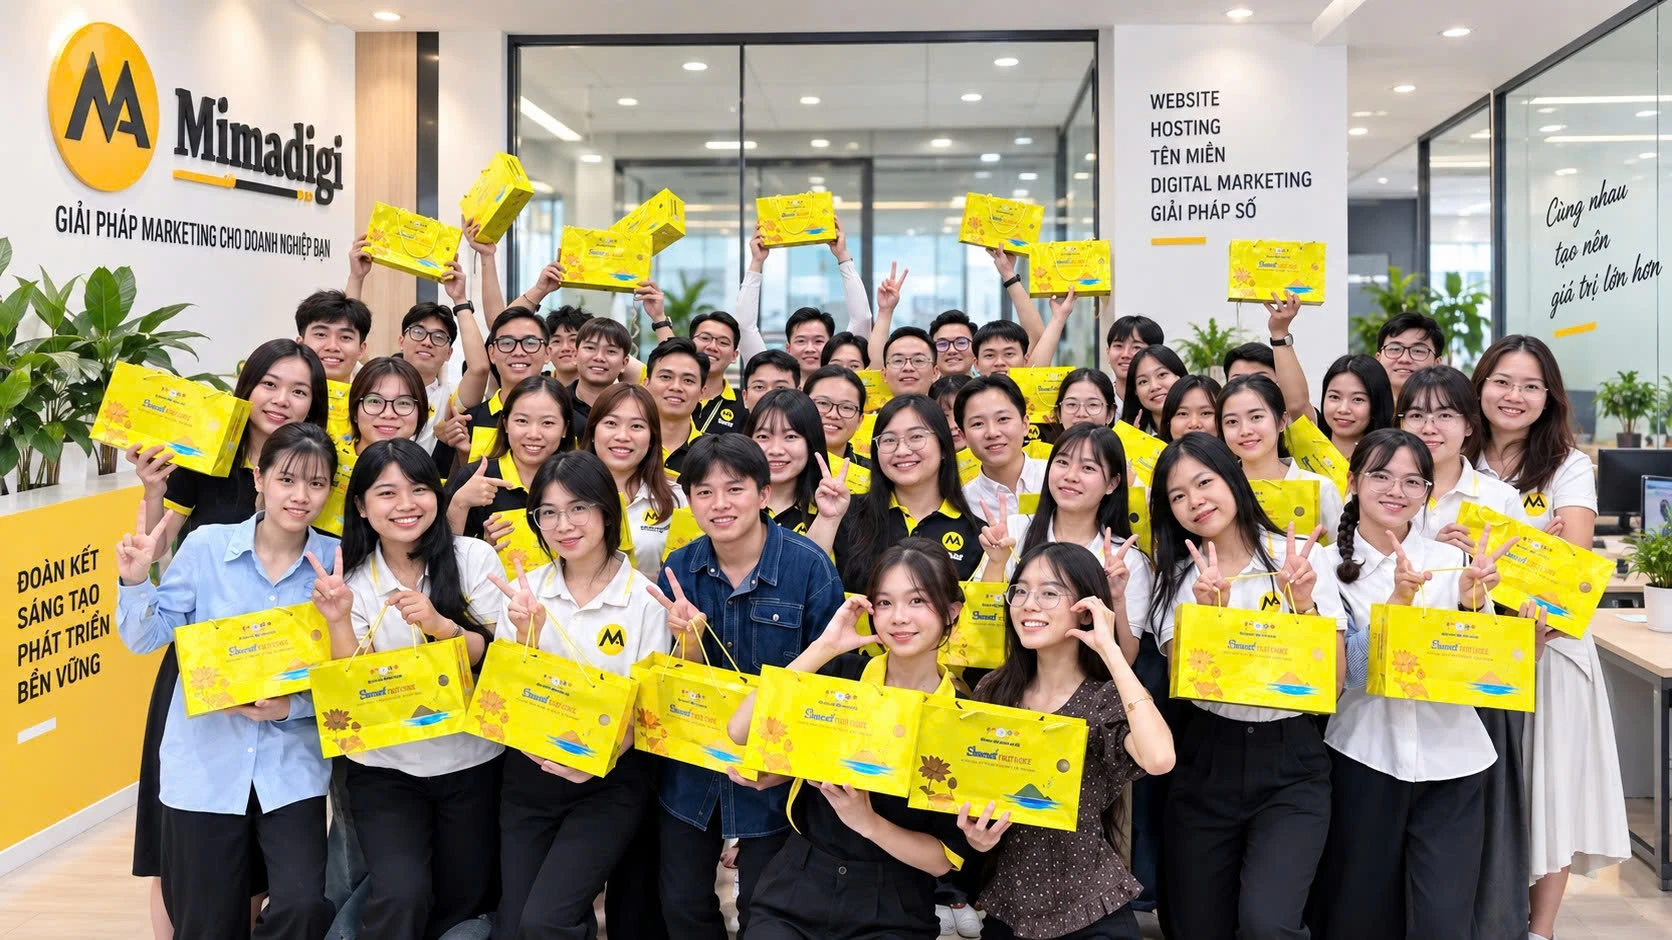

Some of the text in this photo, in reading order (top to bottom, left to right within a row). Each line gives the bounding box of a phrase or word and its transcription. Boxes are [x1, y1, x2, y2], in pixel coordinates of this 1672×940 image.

[1150, 90, 1220, 110] WEBSITE
[173, 87, 344, 206] Mimadigi
[1151, 118, 1221, 138] HOSTING
[1151, 141, 1226, 165] TÊN MIỀN
[1151, 171, 1312, 193] DIGITAL MARKETING
[1546, 179, 1628, 228] Cùng nhau
[1151, 196, 1257, 222] GIẢI PHÁP SỐ
[55, 200, 331, 262] GIẢI PHÁP MARKETING CHO DOANH NGHIỆP BẠN
[1555, 229, 1611, 269] tạo nên
[1550, 253, 1663, 319] giá trị lớn hơn
[17, 544, 99, 594] ĐOÀN KẾT
[17, 583, 100, 629] SÁNG TẠO
[17, 630, 61, 667] PHÁT
[17, 652, 100, 704] BỀN VỮNG
